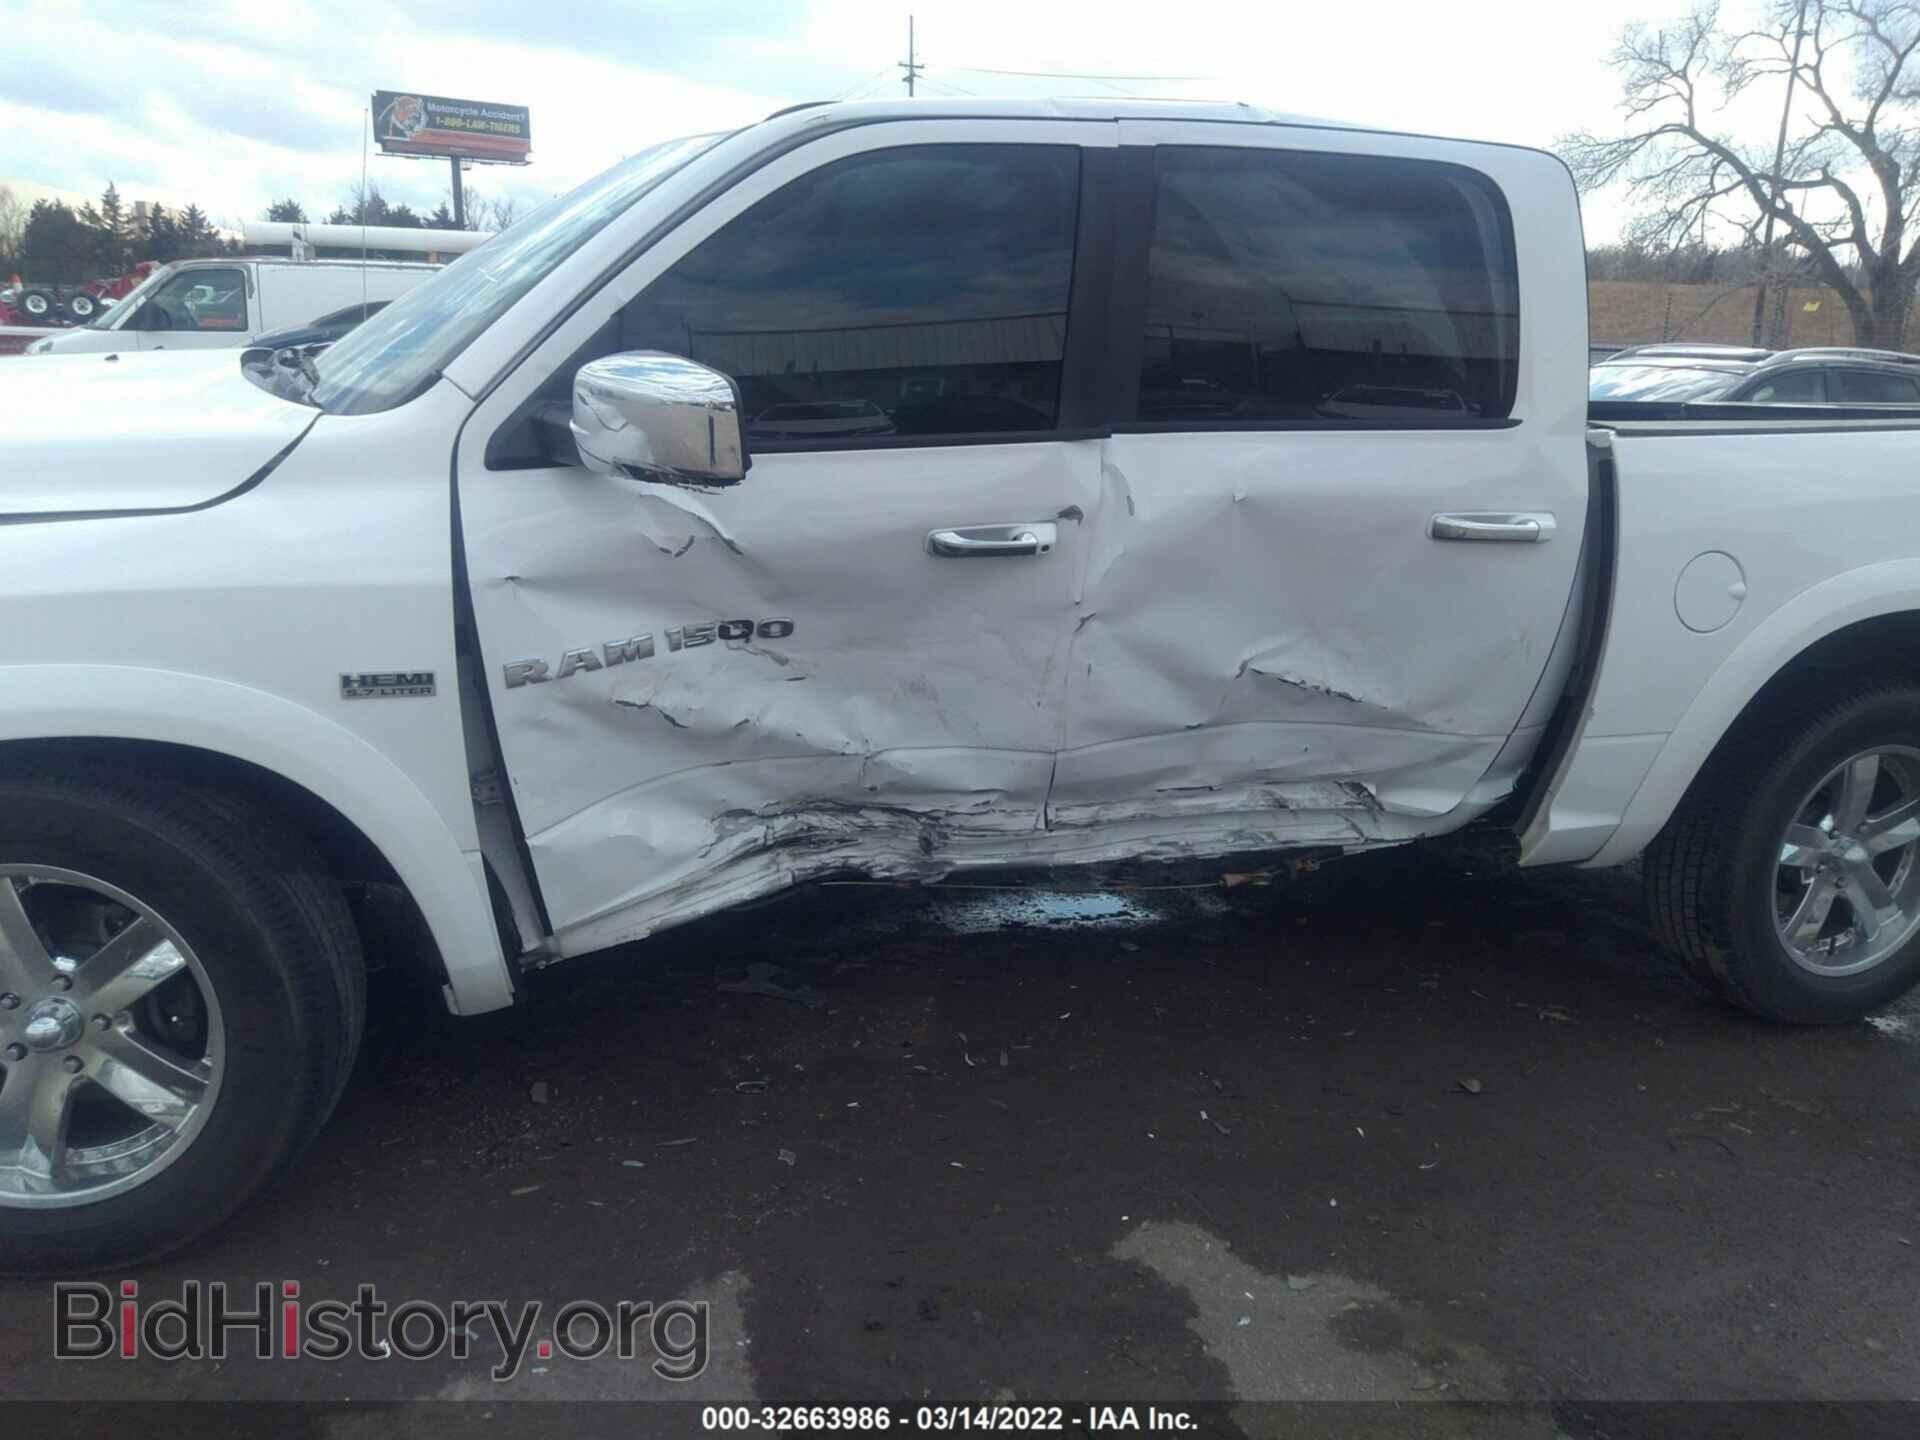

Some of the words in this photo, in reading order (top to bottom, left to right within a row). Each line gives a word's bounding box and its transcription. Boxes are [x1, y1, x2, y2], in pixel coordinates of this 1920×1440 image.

[427, 102, 480, 116] Motorcycle
[480, 107, 526, 121] Accident?
[502, 630, 656, 689] RAM
[663, 617, 795, 652] 1500
[341, 672, 435, 688] HEMI
[380, 687, 433, 697] LITER
